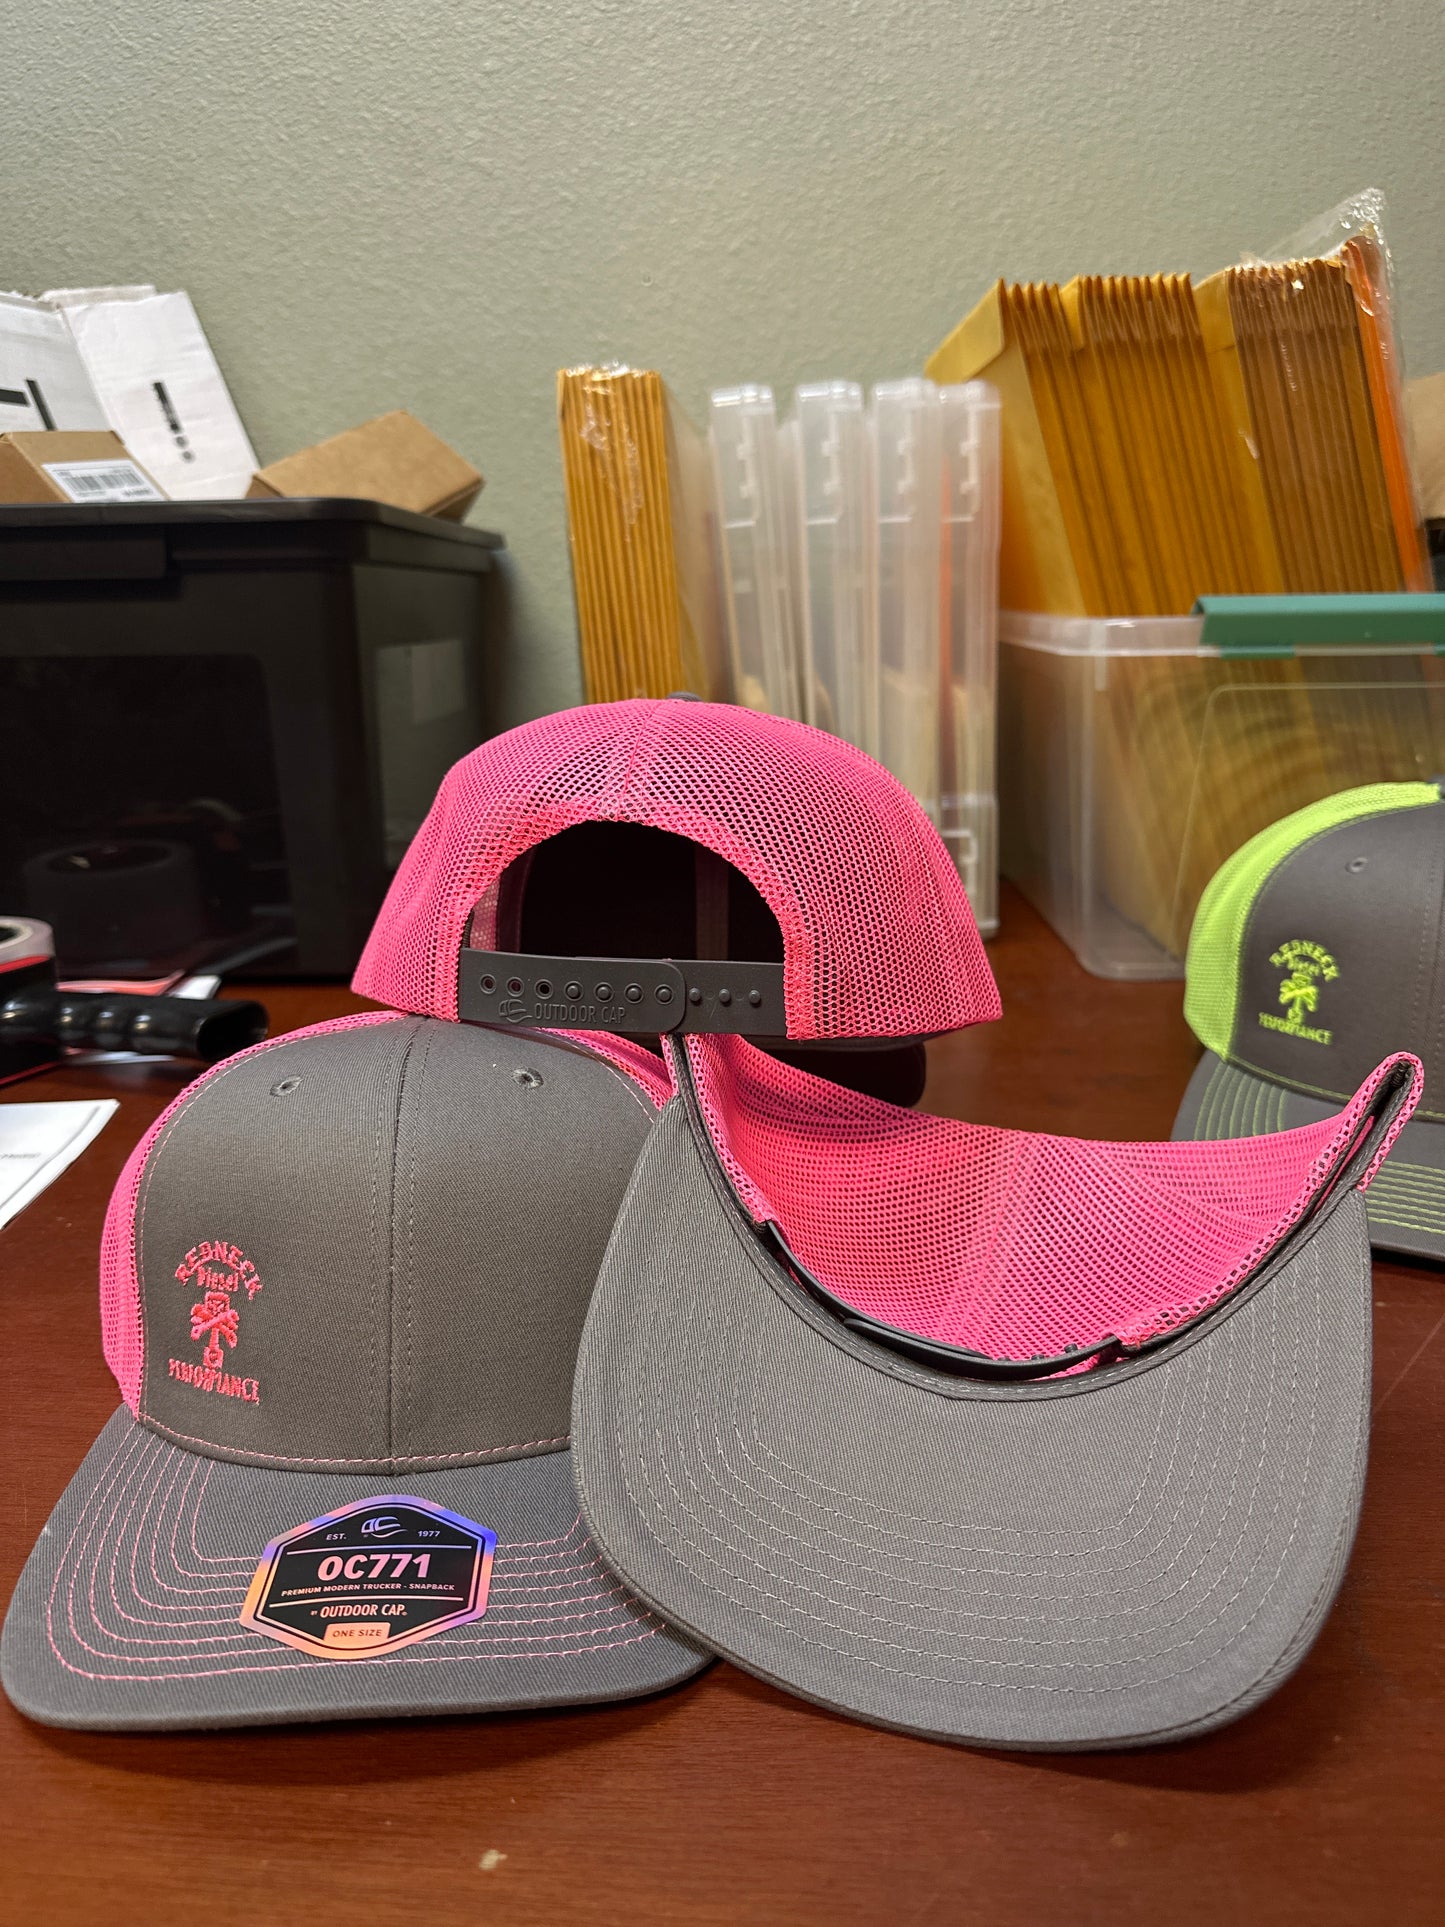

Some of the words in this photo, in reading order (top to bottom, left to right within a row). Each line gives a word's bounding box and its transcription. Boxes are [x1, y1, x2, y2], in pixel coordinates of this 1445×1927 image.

[534, 1002, 596, 1023] OUTDOOR
[601, 1006, 625, 1024] CAP
[175, 1240, 263, 1300] REDNECK
[169, 1358, 260, 1405] PERFORMANCE
[326, 1533, 347, 1541] EST.
[317, 1553, 431, 1581] OC771
[281, 1586, 322, 1597] PREMIUM
[323, 1584, 360, 1592] MODERN
[409, 1583, 455, 1591] SNAPBACK
[320, 1605, 378, 1618] OUTDOOR
[332, 1629, 354, 1638] ONE
[358, 1629, 382, 1637] SIZE
